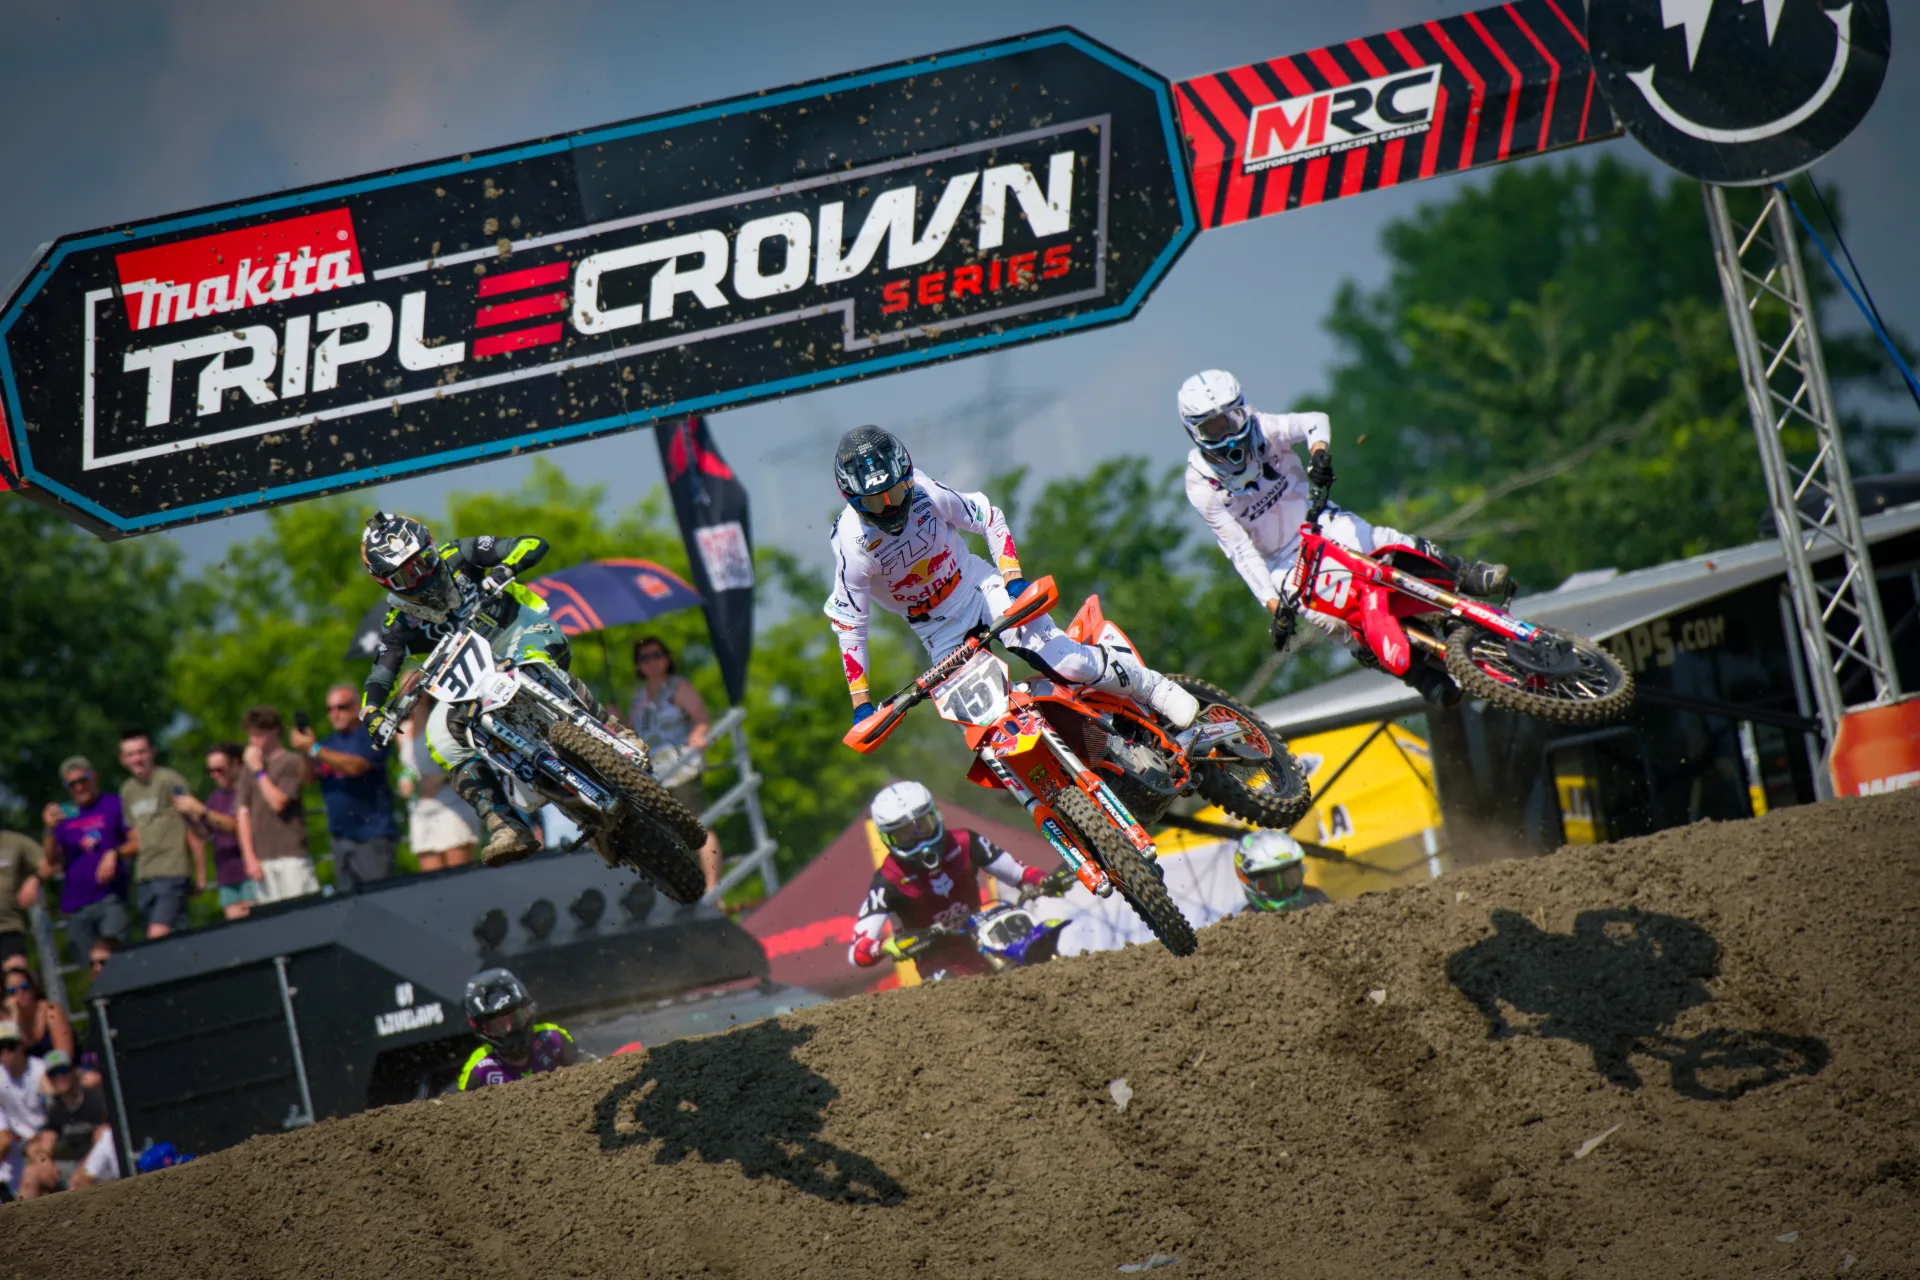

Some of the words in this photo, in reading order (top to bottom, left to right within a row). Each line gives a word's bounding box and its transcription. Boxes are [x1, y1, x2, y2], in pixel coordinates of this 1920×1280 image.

[1250, 71, 1435, 160] MRC
[1244, 147, 1329, 175] MOTORSPORT
[1330, 136, 1378, 155] RACING
[1379, 123, 1431, 142] CANADA
[123, 261, 570, 428] TRIPLE
[572, 151, 1075, 335] CROWN
[881, 244, 1073, 315] SERIES
[864, 473, 890, 490] FLY
[1251, 475, 1286, 511] HONDA
[880, 517, 937, 576] FLY
[893, 586, 932, 602] Red
[1315, 555, 1353, 610] 9
[436, 634, 487, 700] 377
[942, 658, 1009, 725] 151
[1049, 837, 1078, 872] MOTOREX
